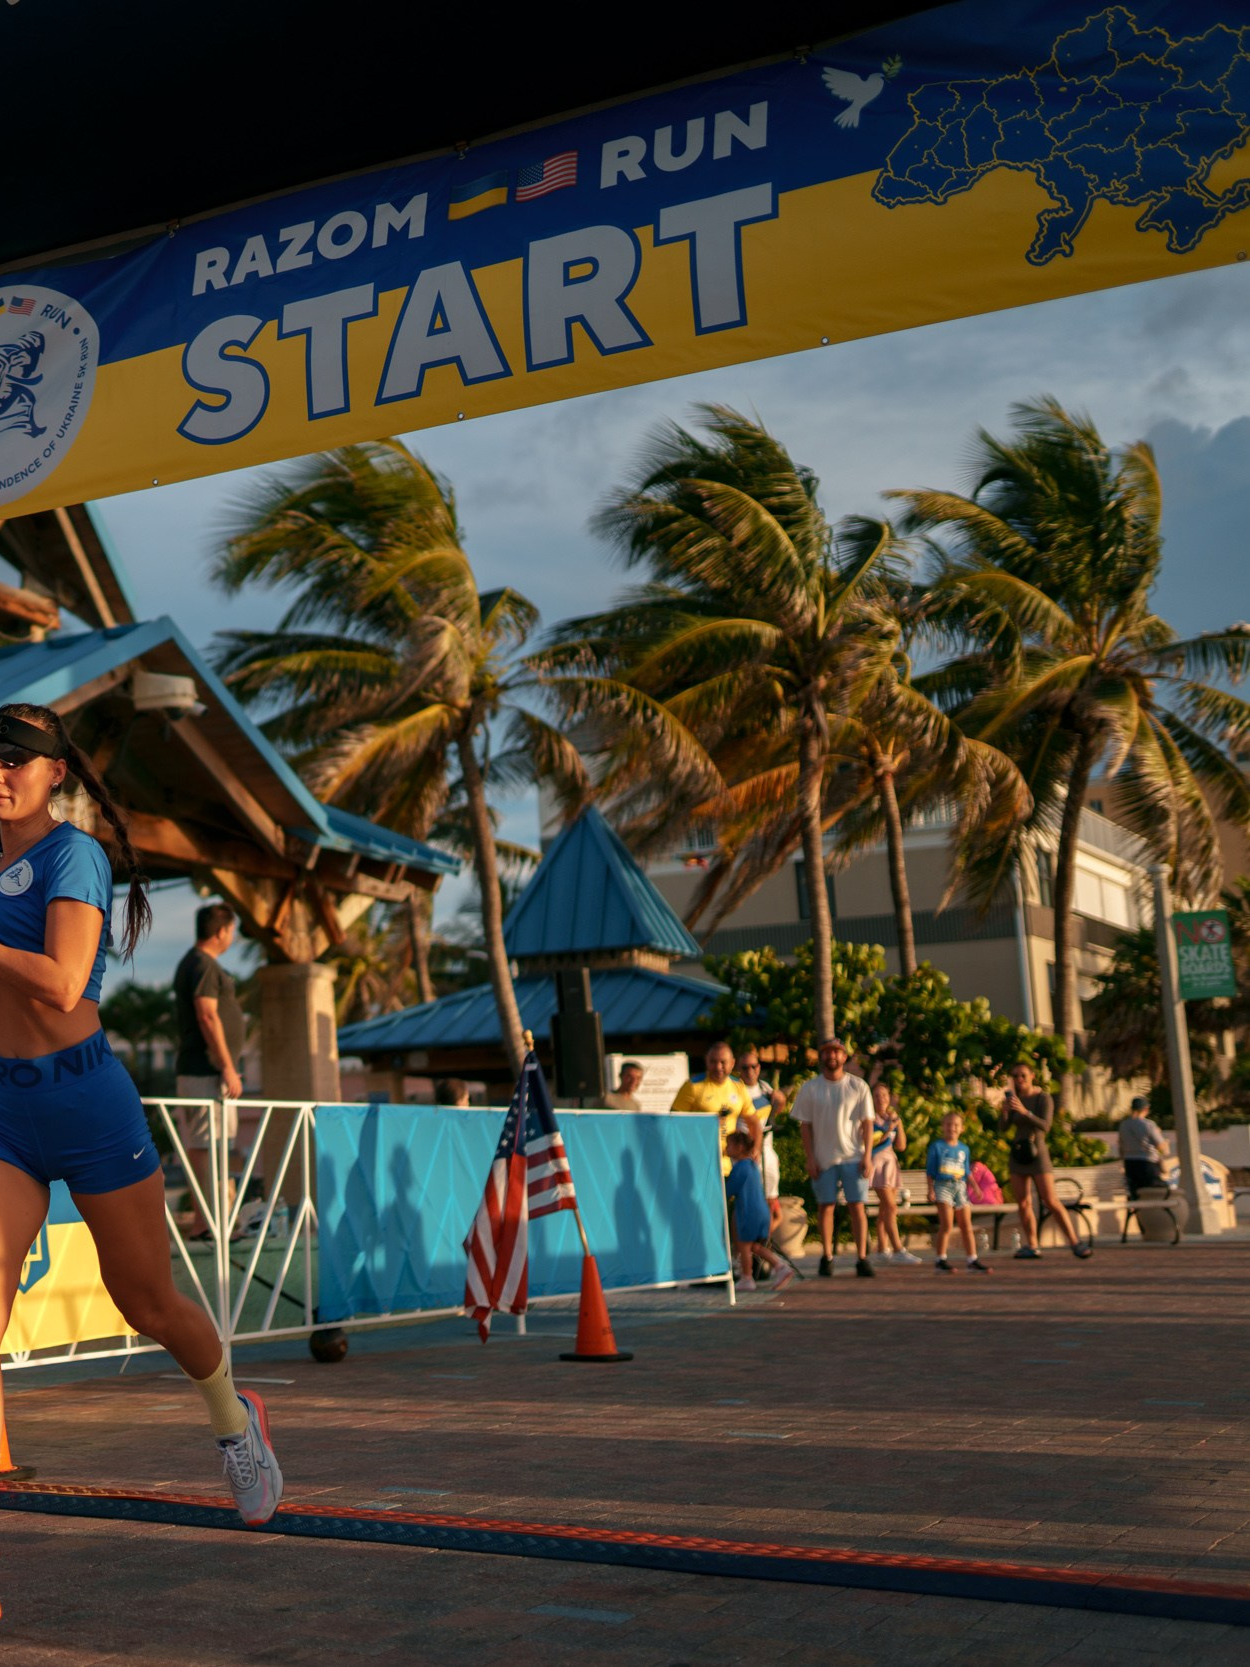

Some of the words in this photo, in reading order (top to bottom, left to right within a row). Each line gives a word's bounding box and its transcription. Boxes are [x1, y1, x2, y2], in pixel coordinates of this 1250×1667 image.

[191, 192, 428, 296] RAZOM
[599, 100, 768, 189] RUN
[40, 304, 72, 330] RUN
[176, 181, 780, 445] START
[79, 336, 89, 362] RUN
[77, 362, 88, 378] 5K
[56, 382, 83, 439] UKRAINE
[42, 440, 57, 458] OF
[1179, 943, 1230, 961] SKATE
[1181, 960, 1231, 976] BOARDS
